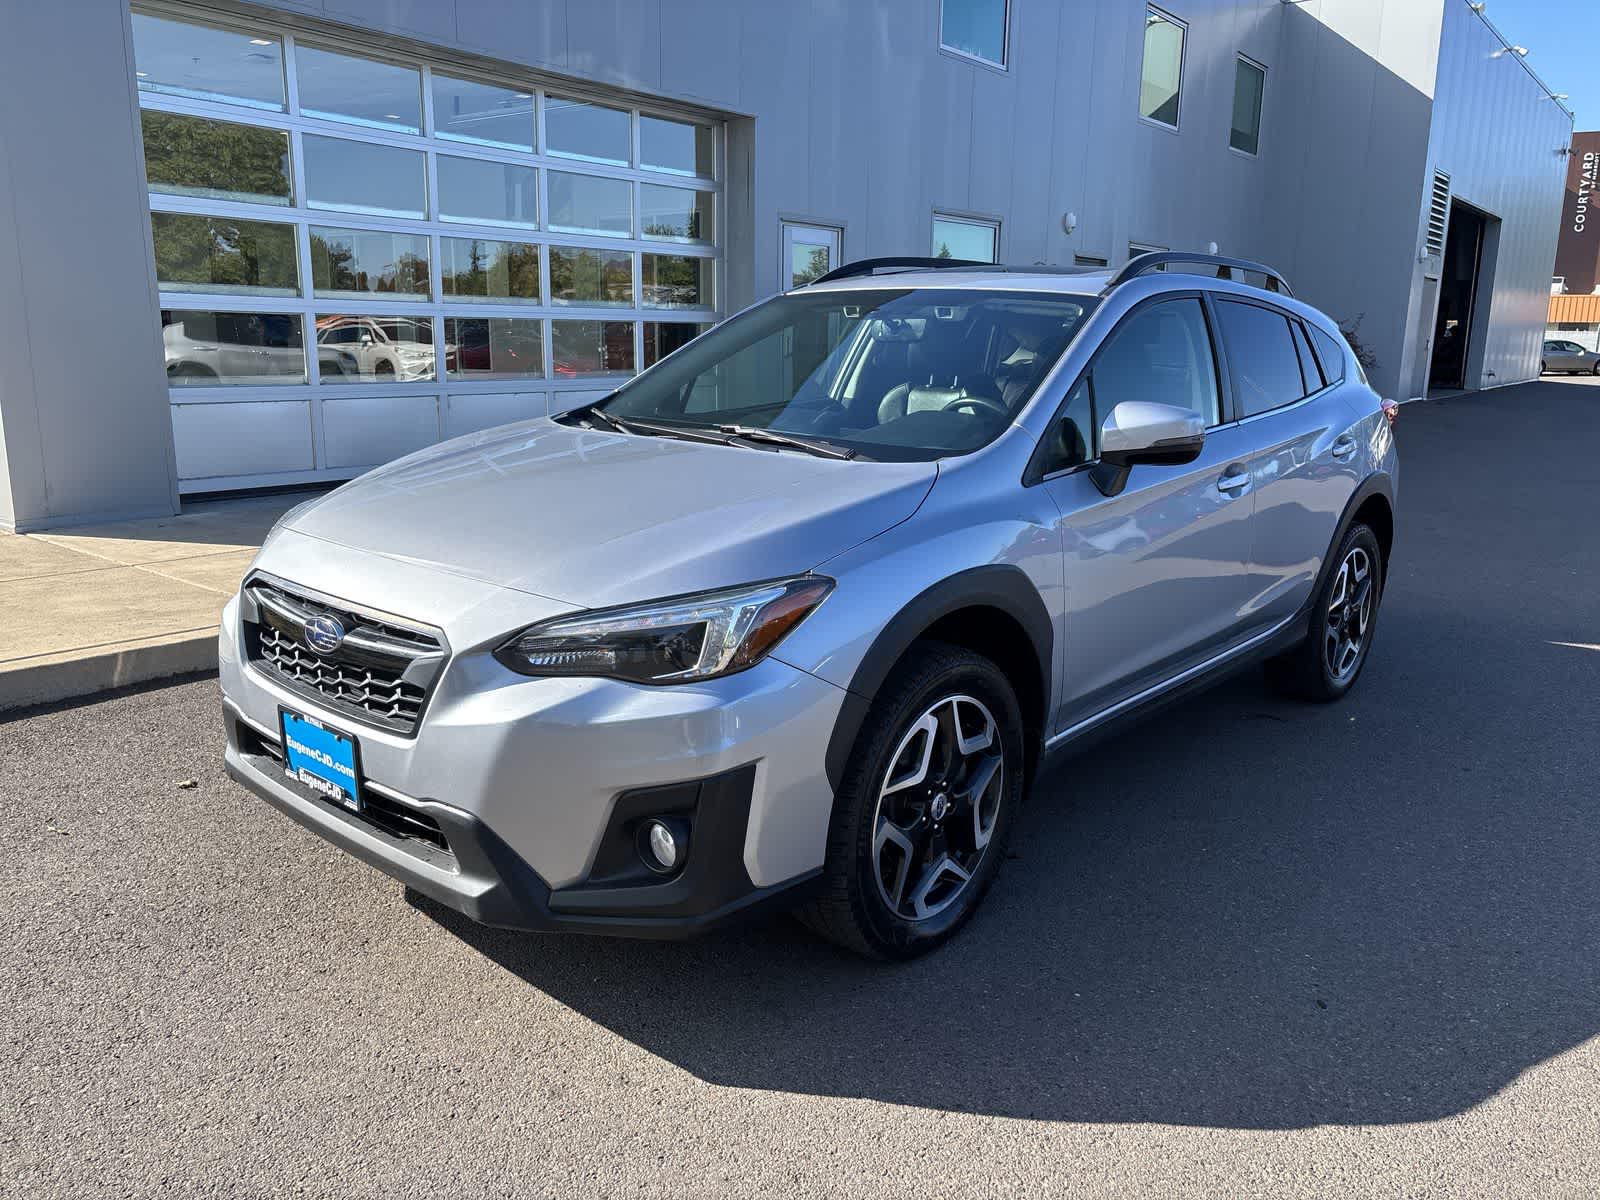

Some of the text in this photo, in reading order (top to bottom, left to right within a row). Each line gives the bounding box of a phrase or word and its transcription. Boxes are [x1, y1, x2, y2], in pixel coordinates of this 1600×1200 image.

[1574, 152, 1594, 233] COURTYARD
[286, 734, 354, 778] EugeneCJD.com
[299, 769, 342, 800] EugeneCJD
